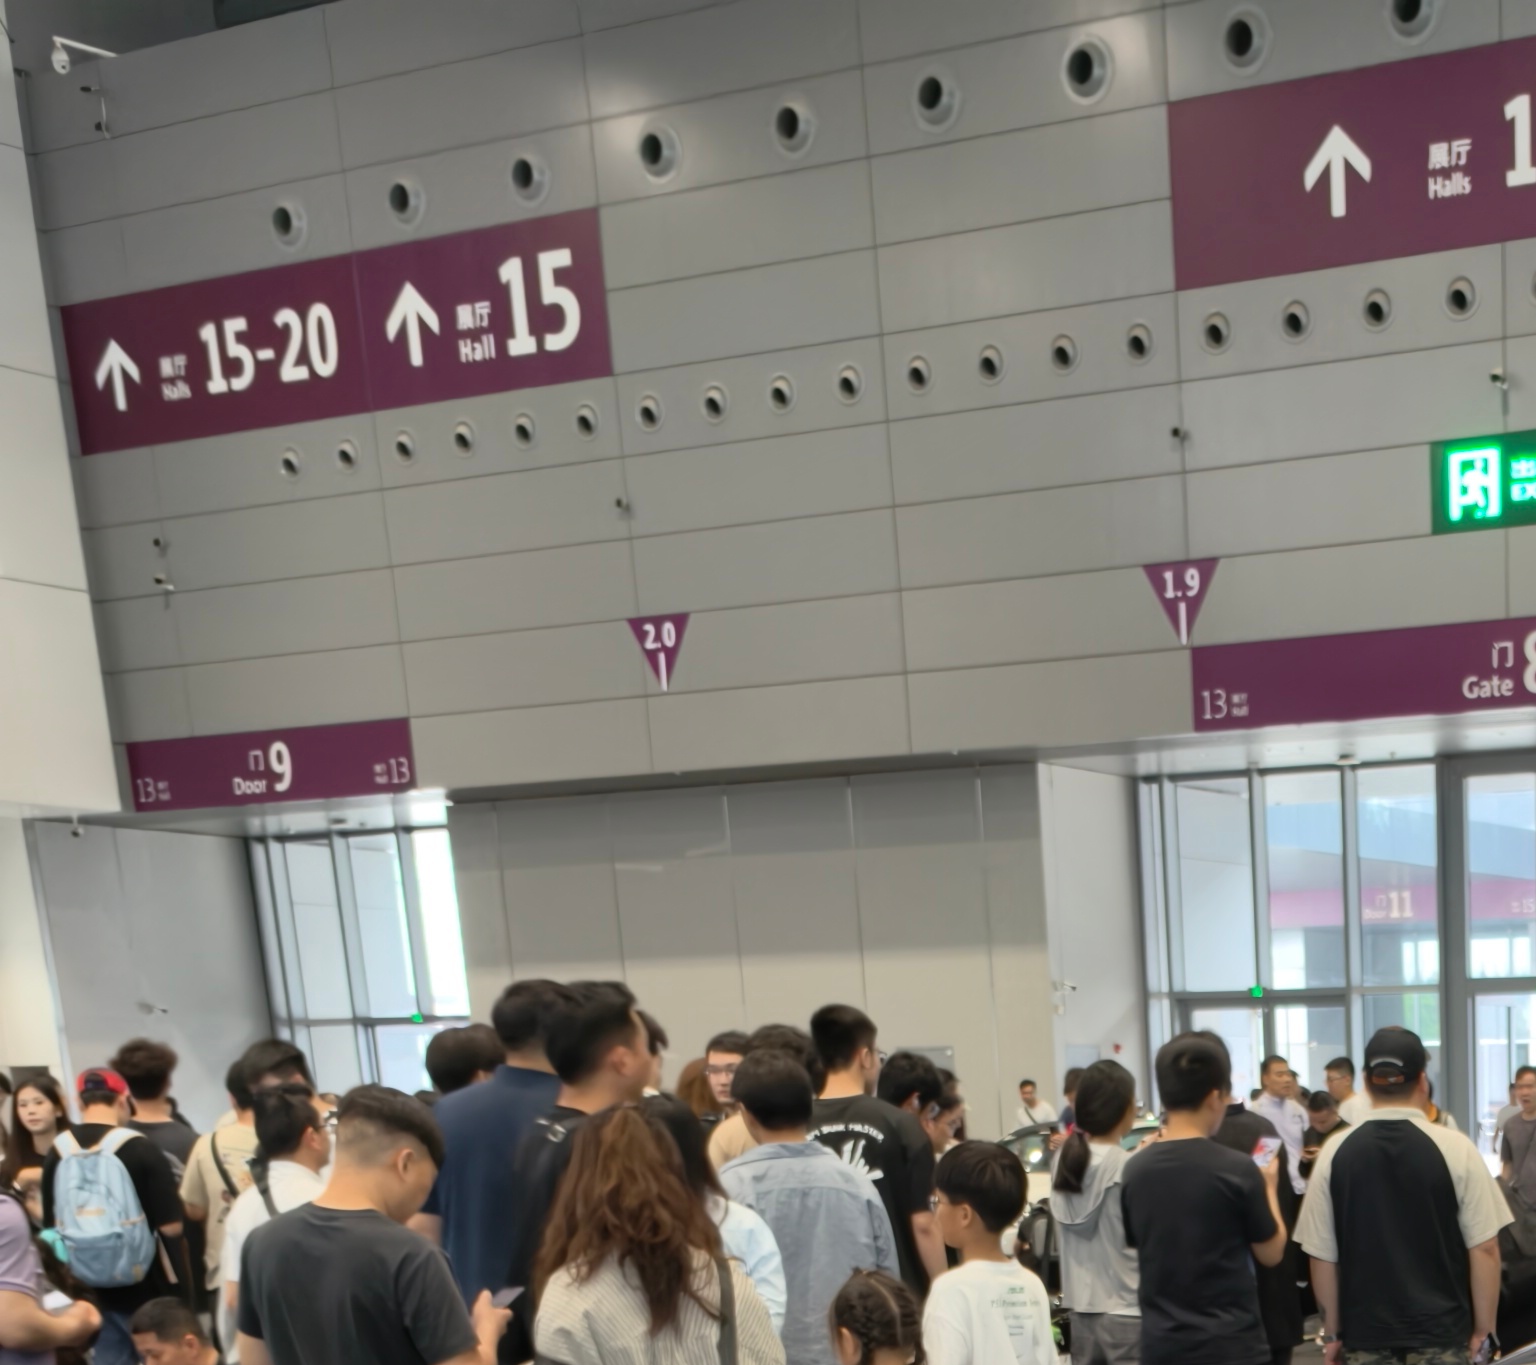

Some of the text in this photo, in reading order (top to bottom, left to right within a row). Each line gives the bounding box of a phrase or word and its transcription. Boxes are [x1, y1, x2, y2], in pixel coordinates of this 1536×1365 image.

[1428, 139, 1471, 170] 展厅
[1428, 172, 1471, 199] Halls
[499, 248, 582, 357] 15
[199, 302, 338, 394] 15-20
[459, 334, 495, 363] Hall
[1162, 567, 1200, 599] 1.9
[642, 621, 677, 650] 2.0
[1492, 641, 1514, 669] 门
[1462, 675, 1515, 699] Gate
[1201, 689, 1228, 719] 13
[268, 741, 293, 792] 9
[389, 757, 411, 784] 13
[136, 778, 157, 803] 13
[232, 776, 268, 796] Door
